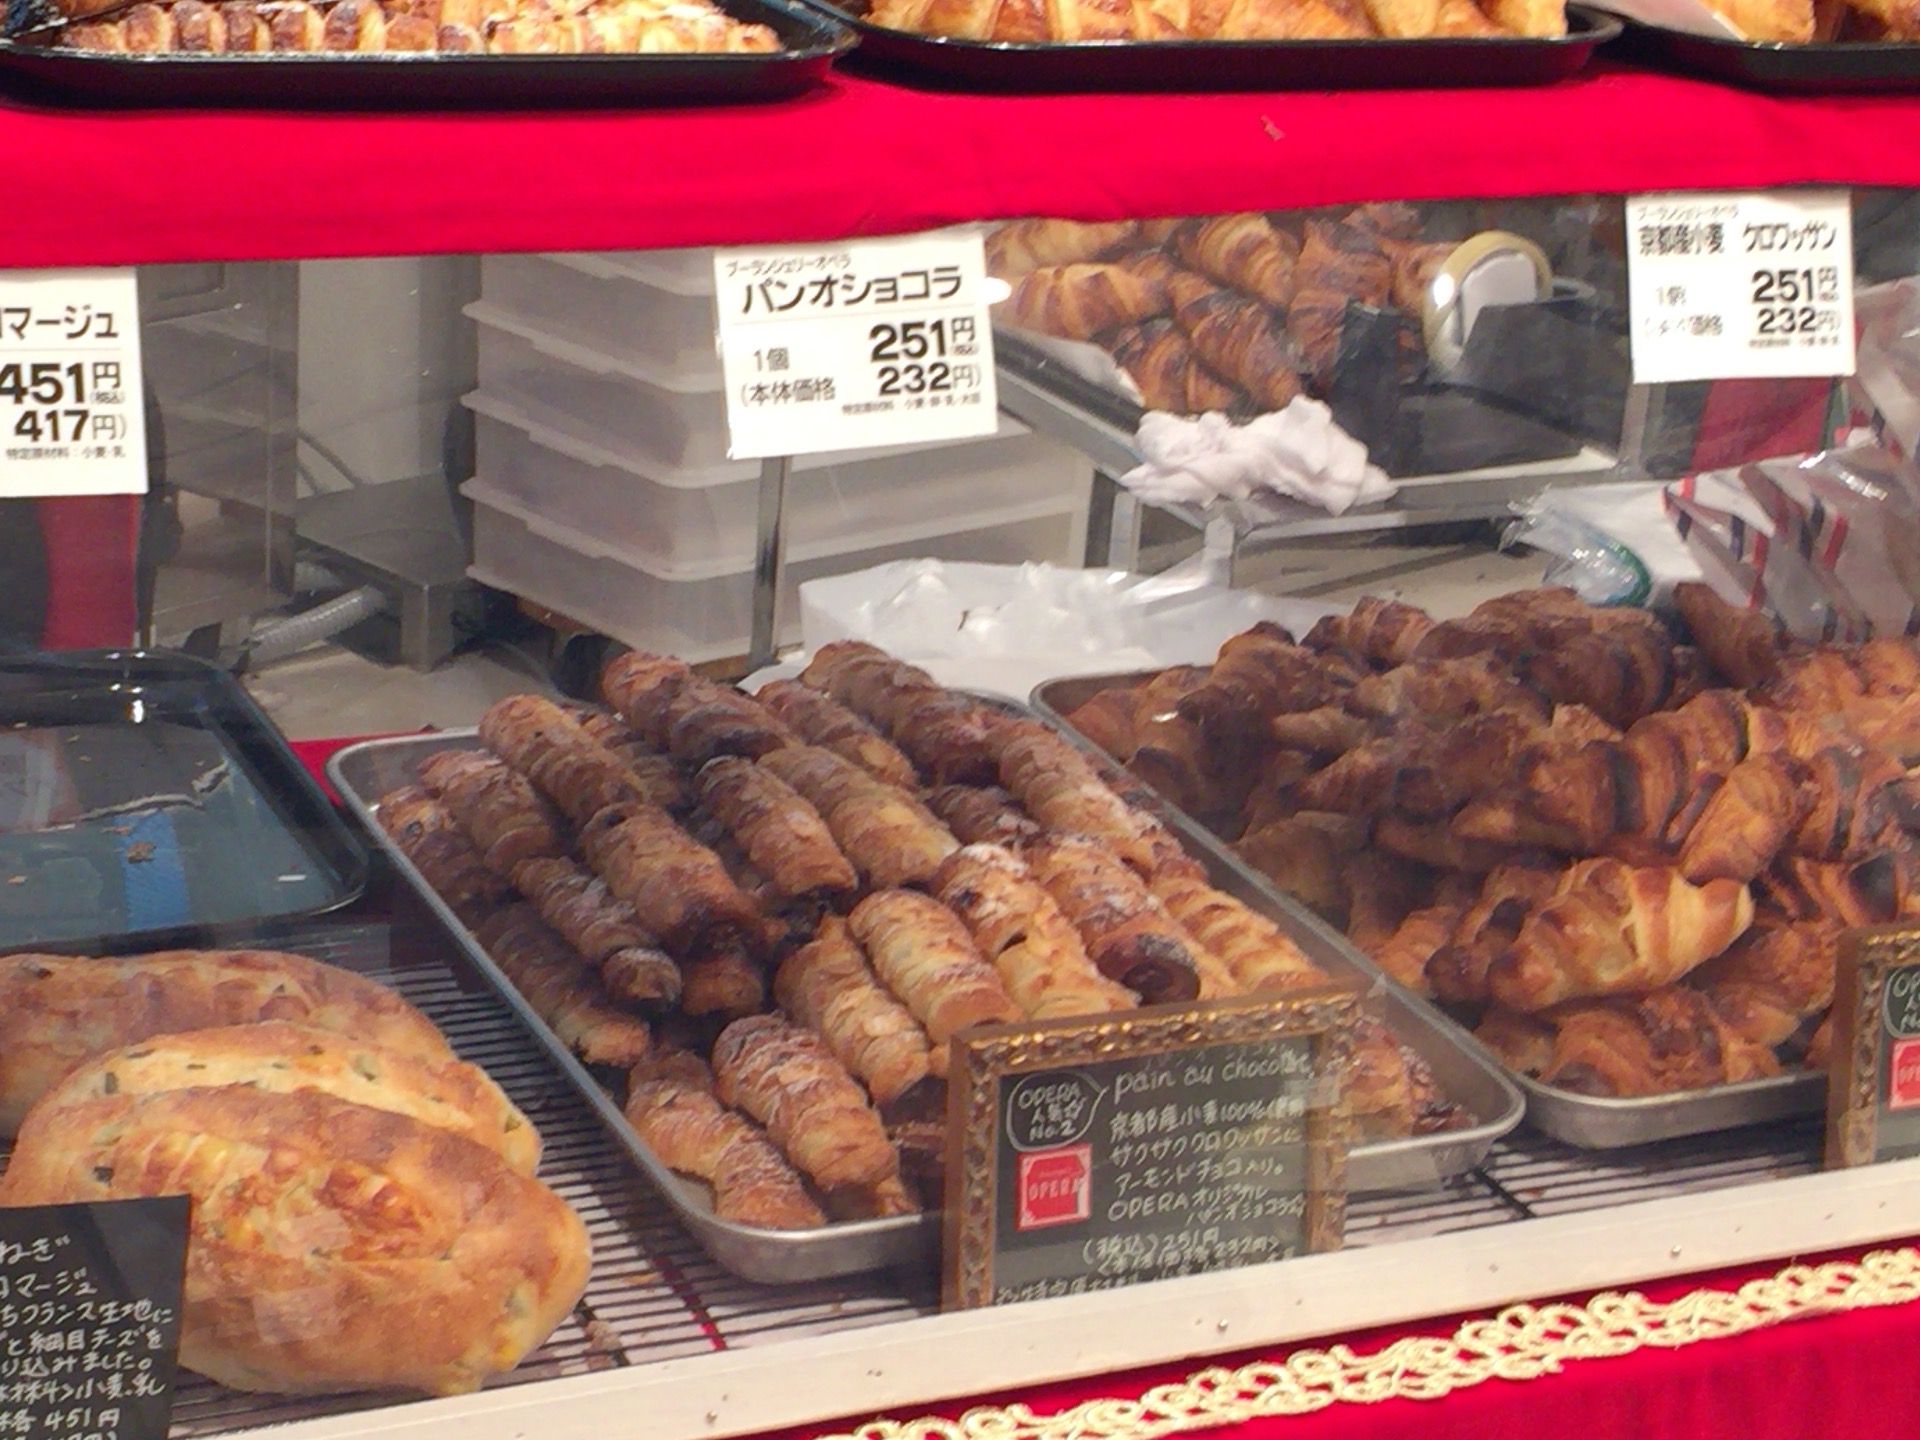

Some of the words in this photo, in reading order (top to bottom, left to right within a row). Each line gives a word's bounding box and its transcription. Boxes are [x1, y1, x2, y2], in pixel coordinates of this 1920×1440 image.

[742, 265, 961, 314] パンオショコラ
[0, 304, 119, 340] マージュ
[753, 347, 790, 371] 1個
[1113, 1070, 1177, 1105] pain
[1184, 1063, 1215, 1086] au
[44, 1407, 120, 1431] 451円
